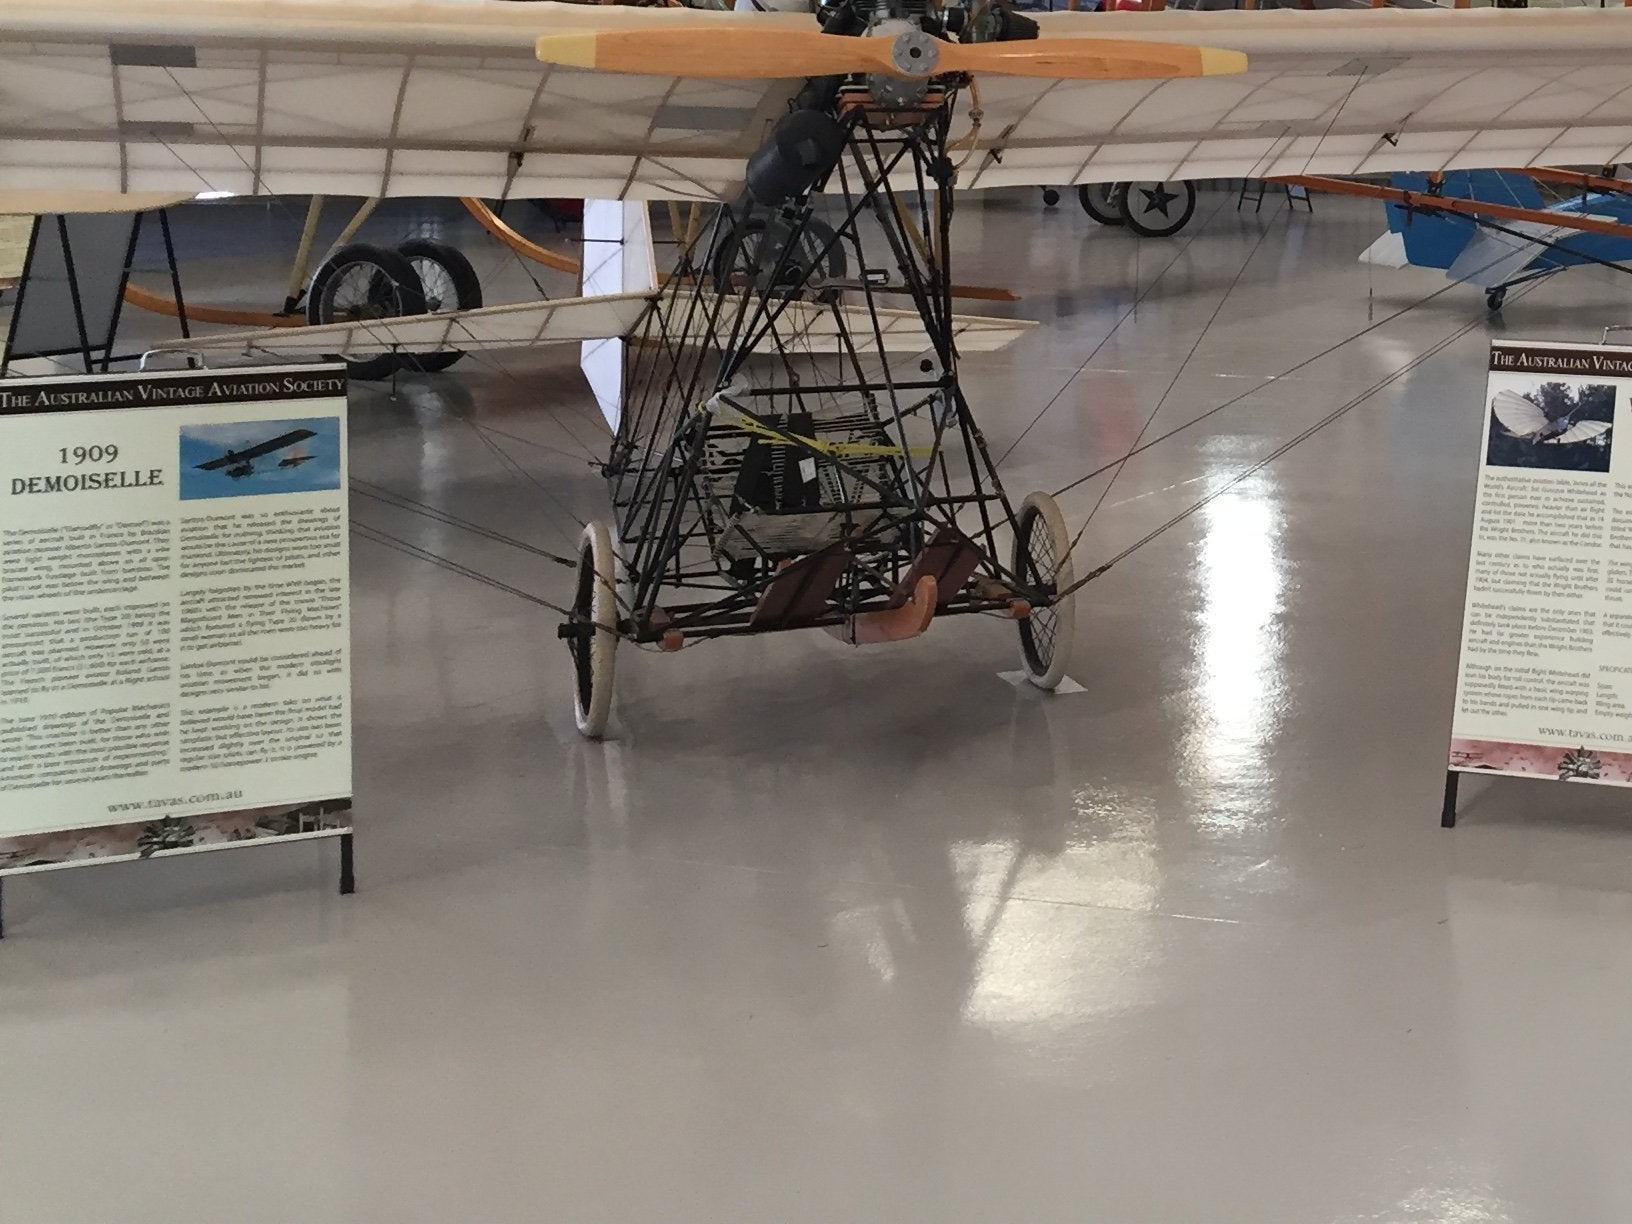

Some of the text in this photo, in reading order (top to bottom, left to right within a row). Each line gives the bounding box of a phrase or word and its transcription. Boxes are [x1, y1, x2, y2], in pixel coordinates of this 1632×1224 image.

[1492, 351, 1515, 366] THE
[1517, 352, 1590, 368] AUSTRALIAN
[34, 390, 134, 407] AUSTRALIAN
[137, 384, 204, 401] VINTAGE
[208, 382, 279, 397] AVIATION
[283, 378, 344, 393] SOCIETY
[58, 444, 119, 465] 1909
[11, 469, 165, 495] DEMOISELLE
[107, 790, 243, 813] www.tavas.com.au
